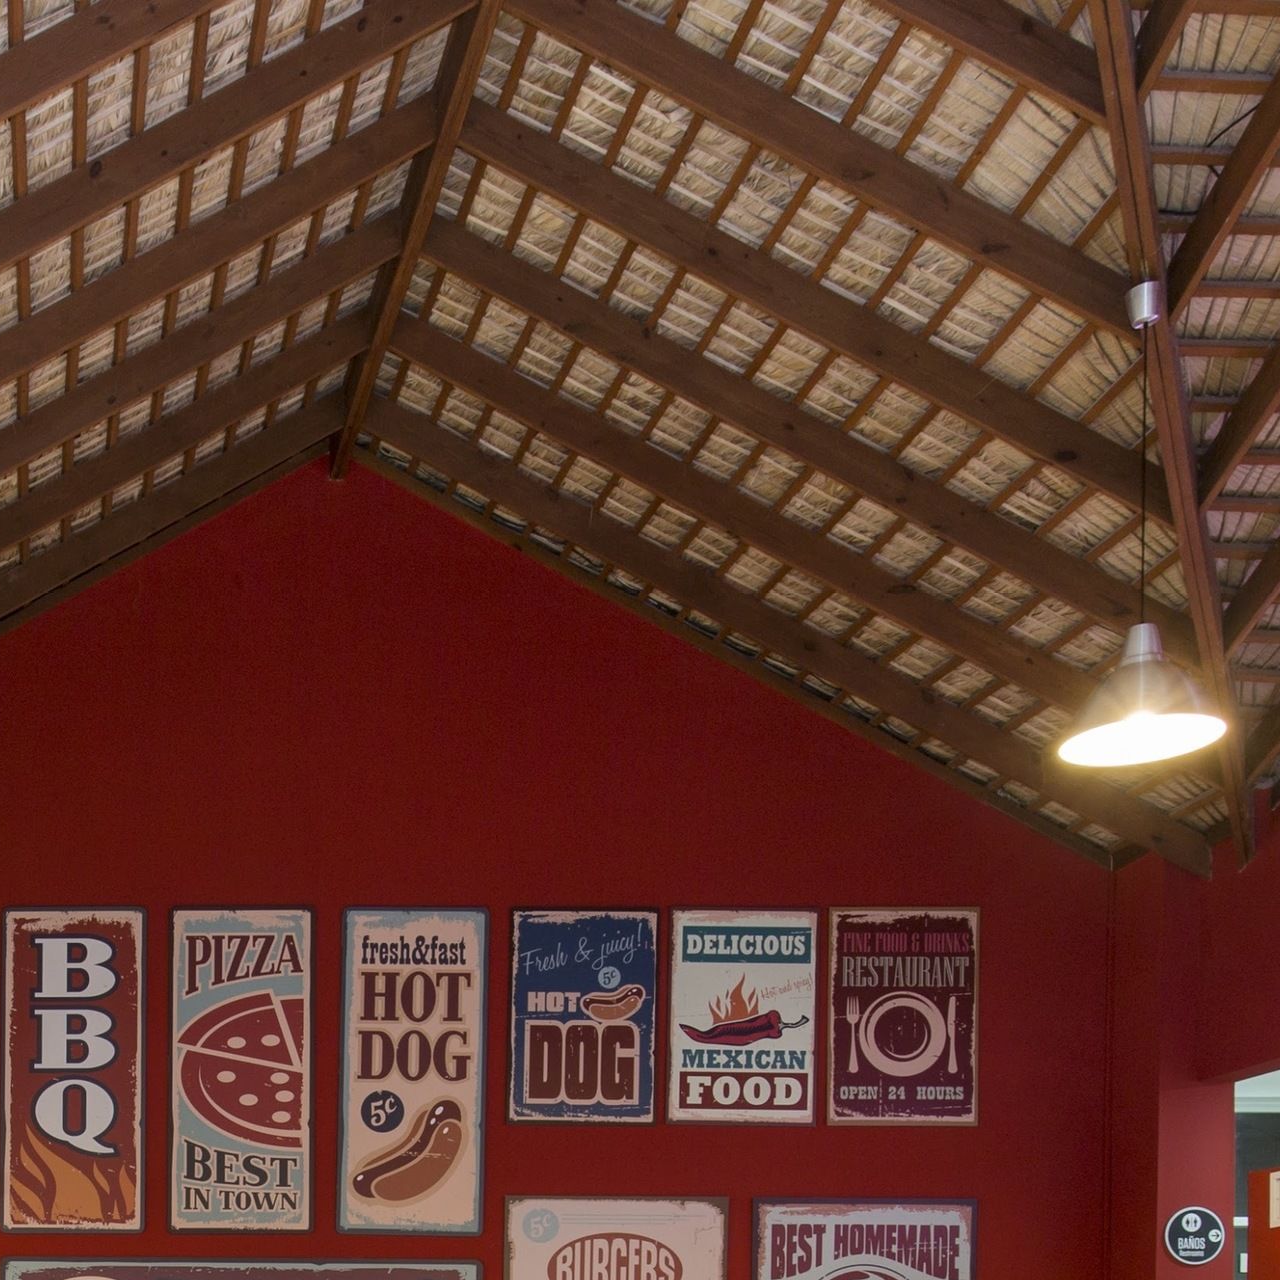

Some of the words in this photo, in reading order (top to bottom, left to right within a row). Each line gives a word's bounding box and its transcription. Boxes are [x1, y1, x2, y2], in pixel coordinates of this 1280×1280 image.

[520, 942, 568, 975] Fresh
[574, 936, 595, 963] &
[592, 922, 642, 970] juicy!
[686, 934, 806, 956] DELICIOUS
[843, 932, 871, 953] FINE
[876, 932, 907, 953] FOOD
[924, 932, 970, 953] DRINKS
[184, 934, 304, 996] PIZZA
[842, 956, 970, 988] RESTAURANT
[360, 971, 471, 1023] HOT
[528, 991, 581, 1012] HOT
[357, 1030, 471, 1081] DOG
[526, 1022, 638, 1103] DOG
[681, 1049, 807, 1070] MEXICAN
[686, 1075, 803, 1106] FOOD
[840, 1086, 878, 1100] OPEN
[888, 1086, 906, 1100] 24
[916, 1086, 964, 1100] HOURS
[183, 1139, 297, 1188] BEST
[184, 1186, 211, 1211] IN
[219, 1190, 298, 1211] TOWN
[770, 1224, 828, 1280] BEST
[1177, 1235, 1206, 1250] BAÑOS
